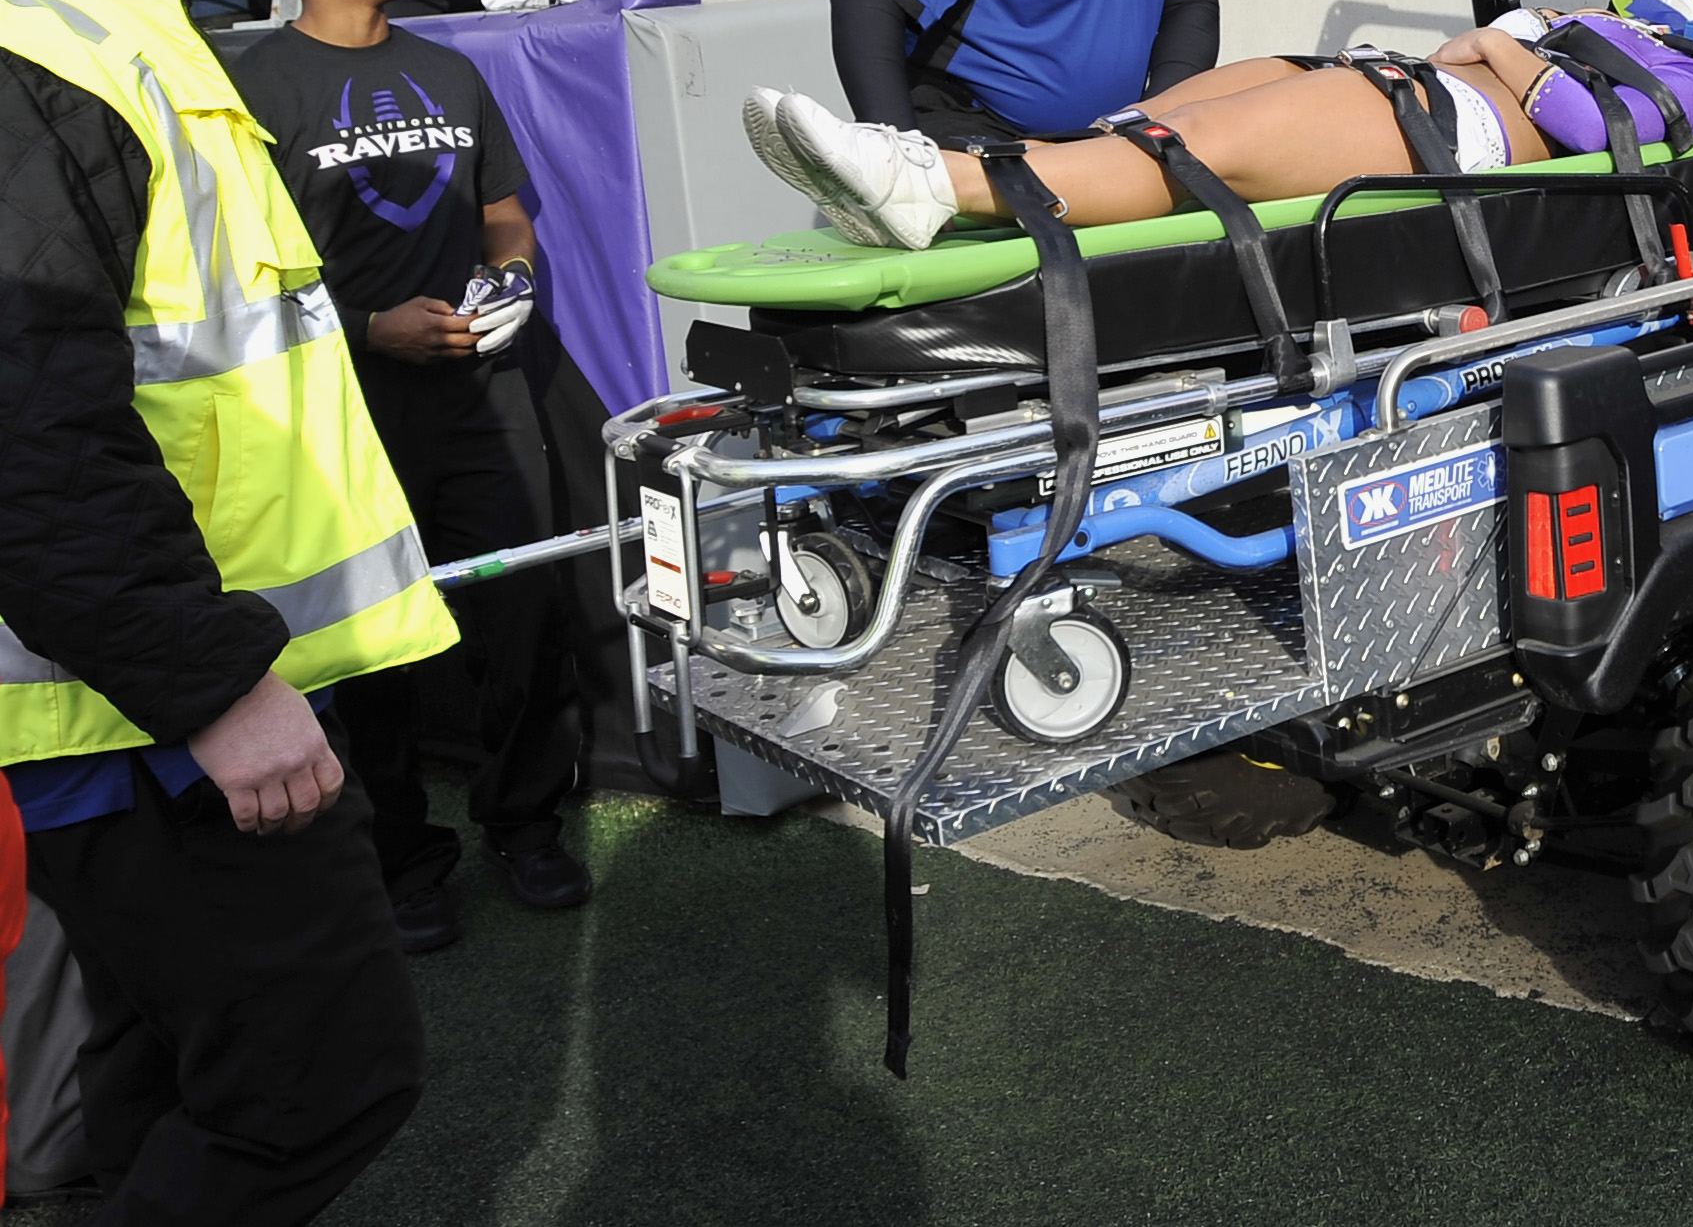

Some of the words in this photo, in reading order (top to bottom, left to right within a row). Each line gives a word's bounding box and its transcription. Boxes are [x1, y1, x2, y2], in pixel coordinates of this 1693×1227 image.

[306, 126, 475, 170] RAVENS
[1141, 438, 1167, 449] HAND
[1168, 431, 1198, 443] GUARD
[1164, 449, 1189, 462] USE
[1189, 442, 1220, 456] ONLY
[1225, 432, 1305, 481] FERNO
[1409, 458, 1474, 498] MEDLITE
[1408, 480, 1473, 514] TRANSPORT
